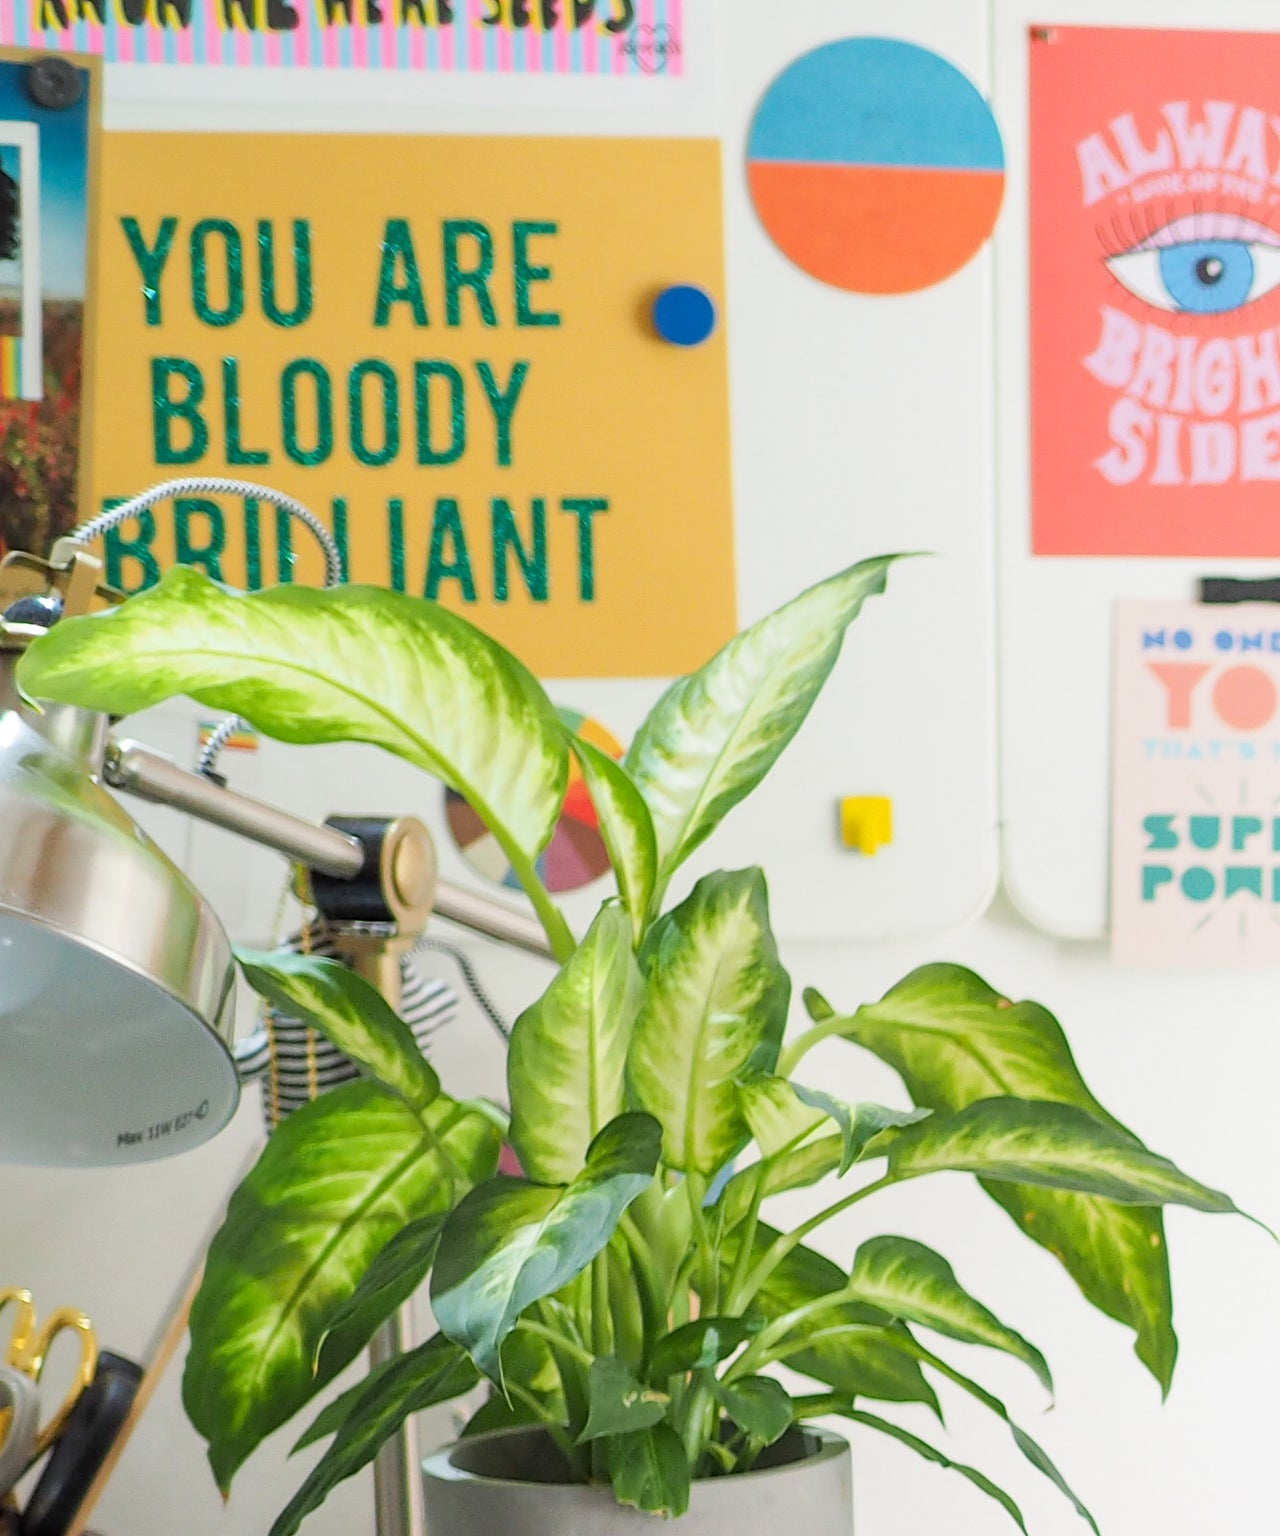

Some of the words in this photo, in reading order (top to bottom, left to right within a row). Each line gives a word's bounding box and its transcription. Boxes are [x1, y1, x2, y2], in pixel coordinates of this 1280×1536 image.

[118, 215, 315, 329] YOU
[373, 218, 562, 329] ARE
[150, 356, 532, 468] BLOODY
